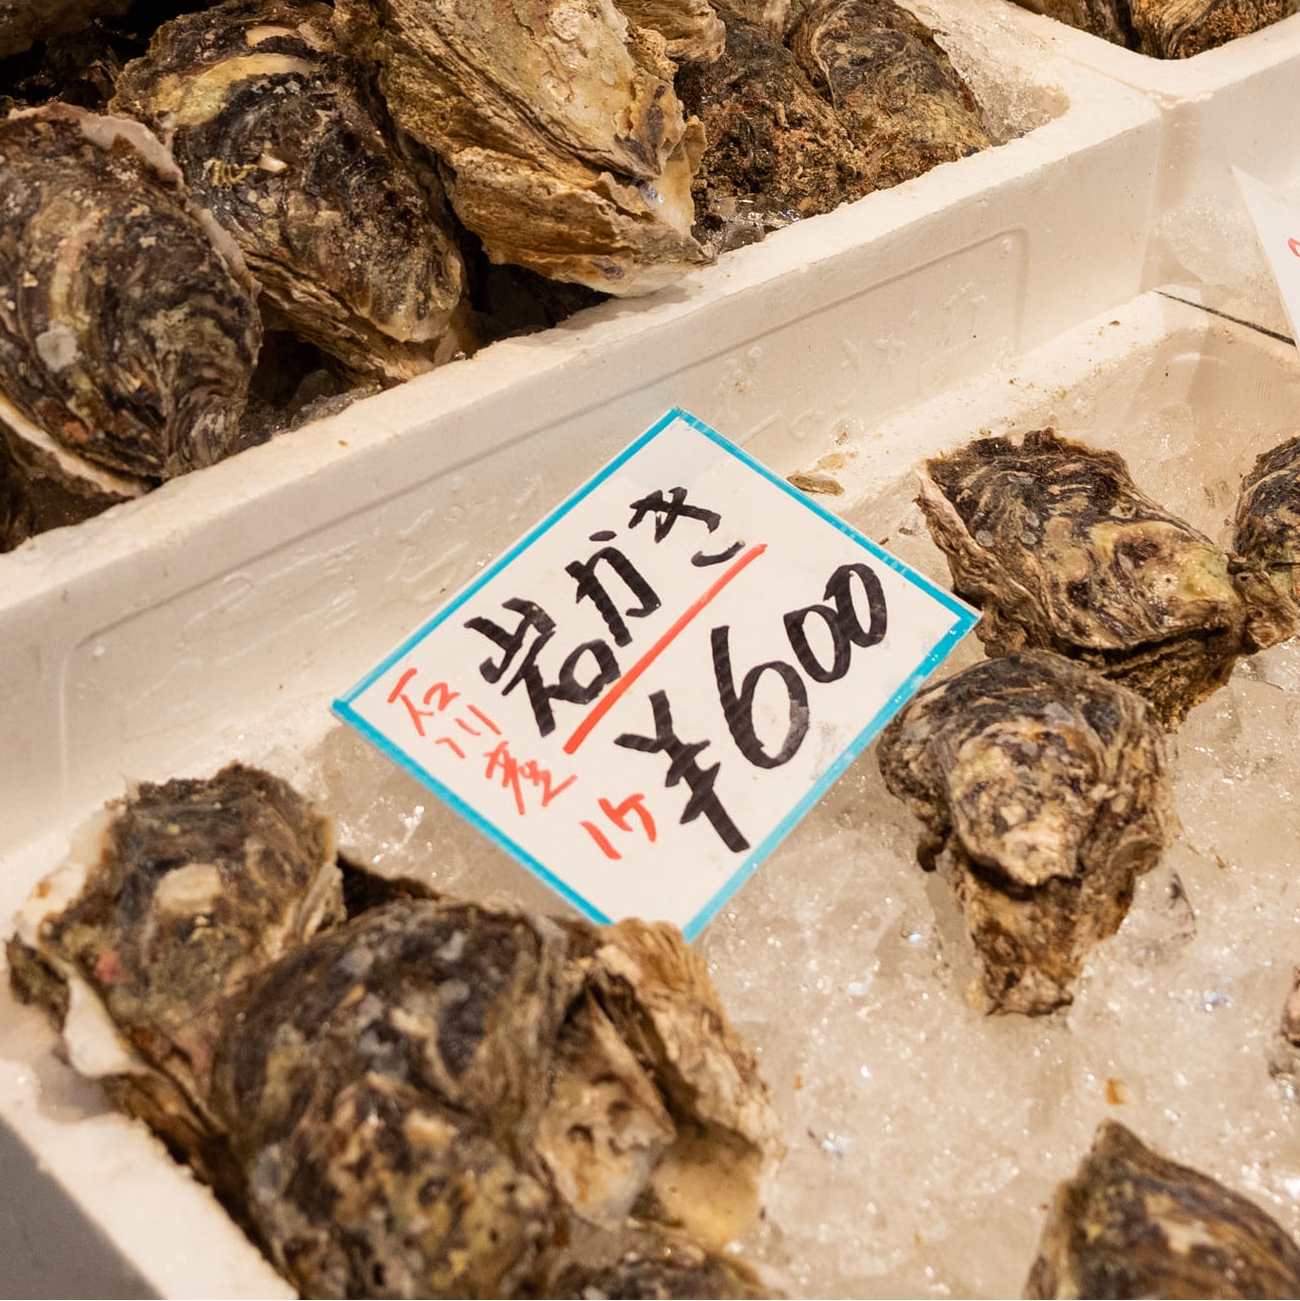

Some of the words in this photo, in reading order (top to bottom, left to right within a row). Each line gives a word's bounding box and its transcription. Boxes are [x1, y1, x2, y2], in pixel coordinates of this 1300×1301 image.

[463, 485, 747, 738] 岩かき
[614, 562, 889, 854] ¥600
[387, 667, 578, 817] 石川産
